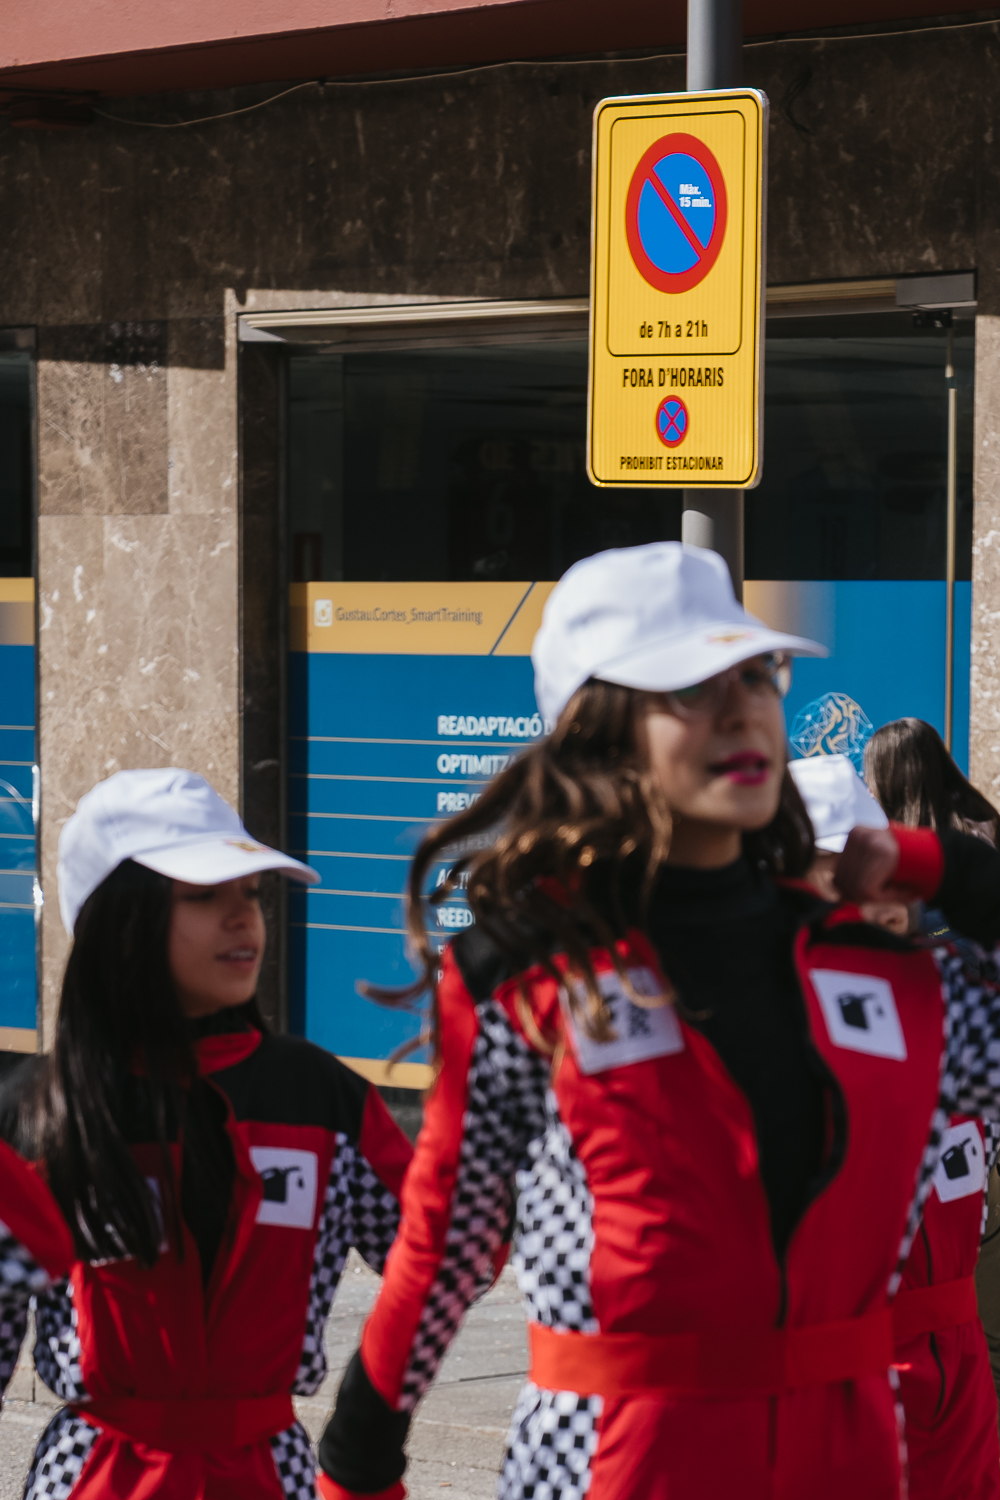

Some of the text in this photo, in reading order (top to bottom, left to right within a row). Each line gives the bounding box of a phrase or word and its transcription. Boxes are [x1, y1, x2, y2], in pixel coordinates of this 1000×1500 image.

[679, 196, 712, 208] 15 min.
[639, 319, 709, 338] de 7h a 21h
[622, 367, 654, 388] FORA
[619, 456, 724, 470] PROHIBIT ESTACIONAR
[437, 712, 543, 737] READAPTACIÓ
[436, 753, 517, 775] OPTIMITZ
[436, 906, 477, 928] REED
